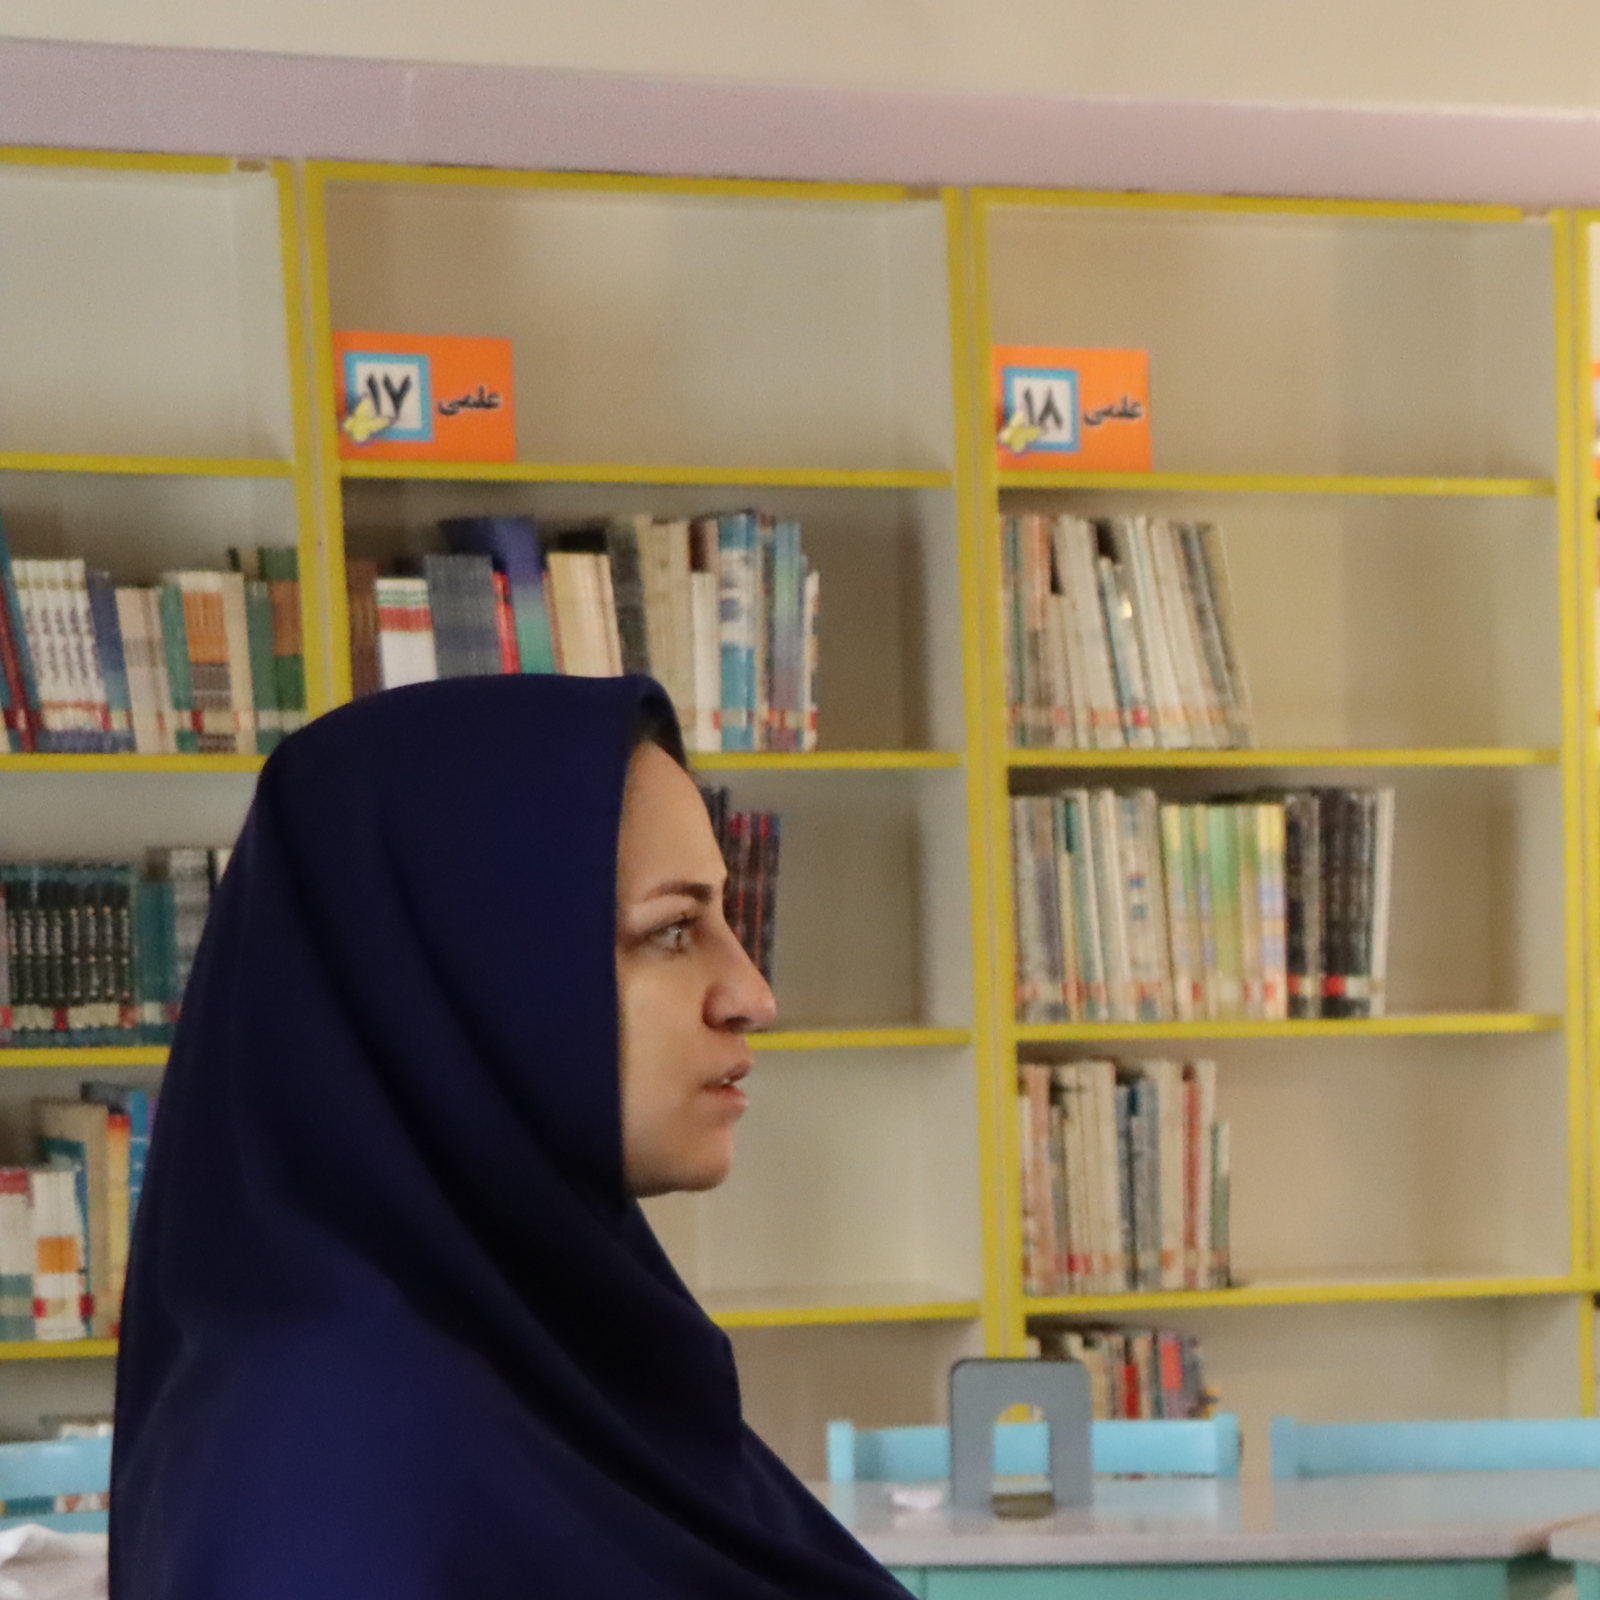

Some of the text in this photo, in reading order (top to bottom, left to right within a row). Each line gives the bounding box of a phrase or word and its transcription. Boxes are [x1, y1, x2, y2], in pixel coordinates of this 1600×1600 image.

[367, 374, 500, 420] علمی ۱۷
[1024, 387, 1143, 432] علمی ۱۸
